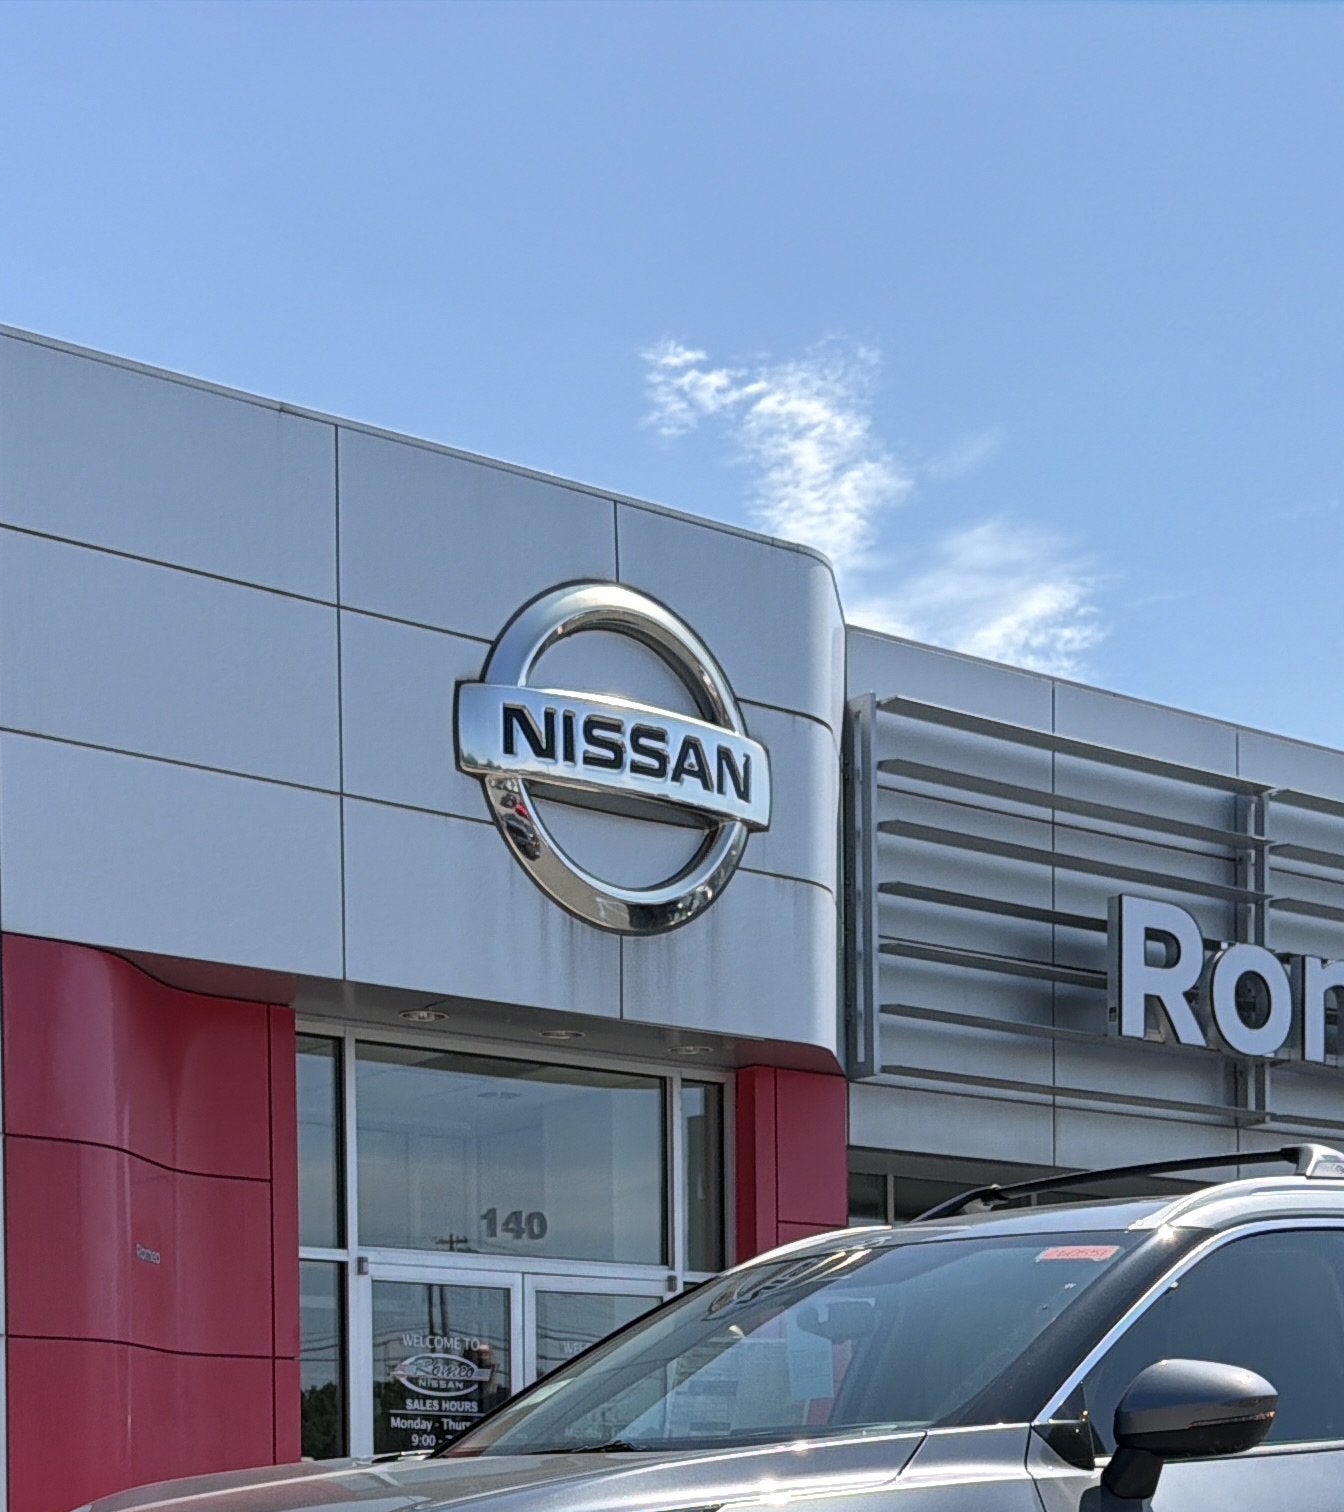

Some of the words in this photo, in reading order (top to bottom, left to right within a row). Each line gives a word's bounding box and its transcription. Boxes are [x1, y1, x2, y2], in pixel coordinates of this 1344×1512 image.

[502, 702, 752, 804] NISSAN
[480, 1207, 548, 1240] 140
[402, 1334, 461, 1350] WELCOME
[465, 1338, 480, 1351] TO
[418, 1378, 464, 1389] NISSAN
[406, 1399, 440, 1411] SALES
[442, 1400, 478, 1412] HOURS
[390, 1416, 433, 1432] Monday
[411, 1434, 436, 1446] 9:00
